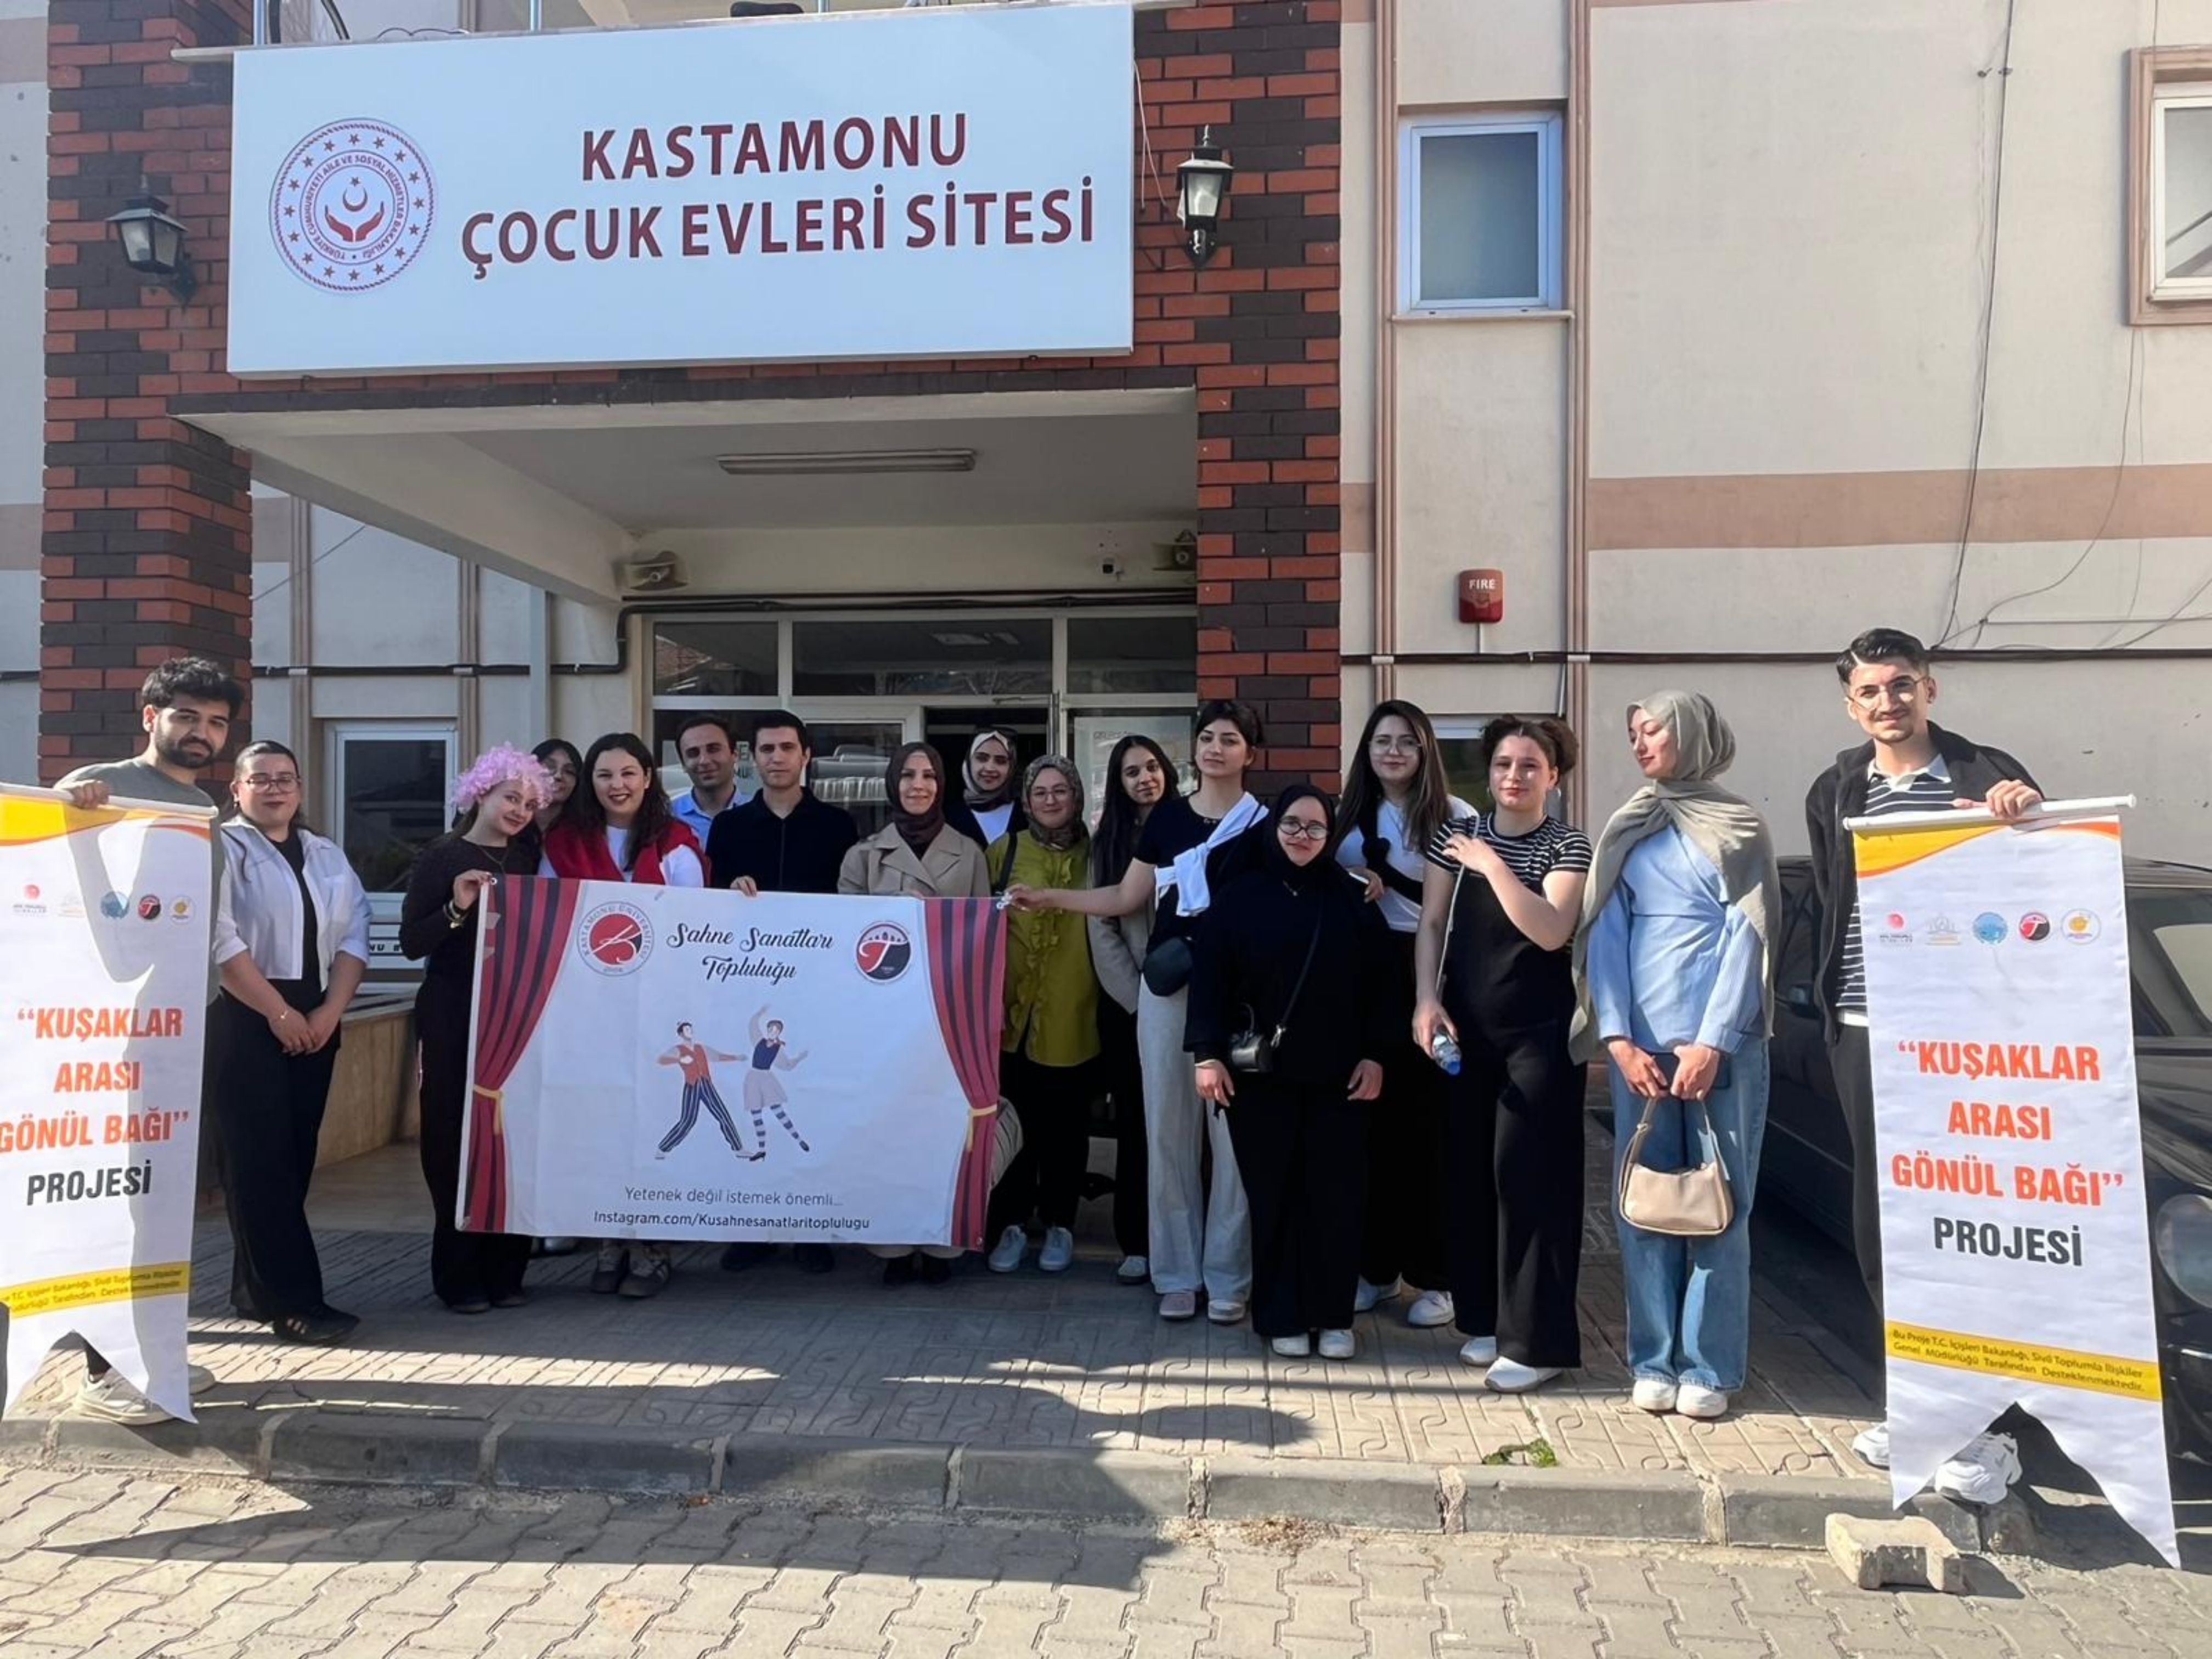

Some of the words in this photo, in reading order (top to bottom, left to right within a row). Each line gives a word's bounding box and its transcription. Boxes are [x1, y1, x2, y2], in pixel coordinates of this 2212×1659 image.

[583, 114, 966, 181] KASTAMONU
[323, 158, 341, 177] AİLE
[341, 155, 353, 164] VE
[354, 155, 385, 173] SOSYAL
[461, 206, 663, 280] ÇOCUK
[681, 184, 885, 256] EVLERİ
[906, 176, 1093, 249] SİTESİ
[1469, 579, 1496, 589] FIRE
[666, 923, 733, 949] Sahne
[740, 927, 833, 952] Sanatları
[702, 956, 796, 985] Topluluğu
[54, 1062, 140, 1092] ARASI
[0, 1110, 93, 1153] GÖNÜL
[1948, 1101, 2051, 1140] ARASI
[27, 1159, 151, 1206] PROJESİ
[1892, 1150, 2004, 1197] GÖNÜL
[625, 1186, 681, 1201] Yetenek
[687, 1189, 723, 1205] değil
[726, 1189, 780, 1205] istemek
[1933, 1217, 2082, 1266] PROJESİ
[1893, 1330, 1905, 1339] Bu
[1907, 1333, 1929, 1345] Proje
[1894, 1342, 1920, 1354] Genel
[1926, 1348, 1979, 1365] Müdürlüğü
[1984, 1358, 2036, 1374] Tarafından
